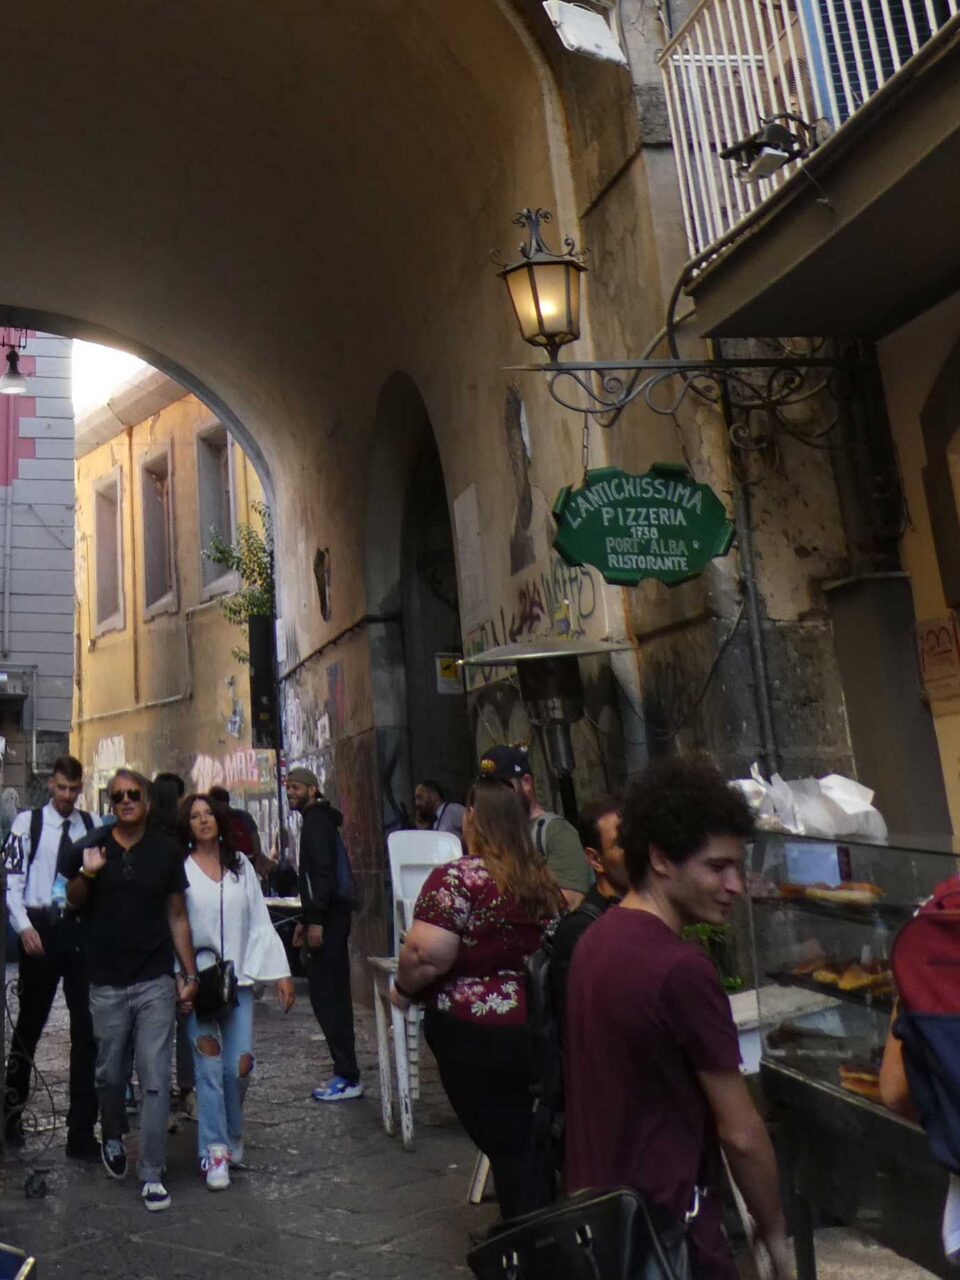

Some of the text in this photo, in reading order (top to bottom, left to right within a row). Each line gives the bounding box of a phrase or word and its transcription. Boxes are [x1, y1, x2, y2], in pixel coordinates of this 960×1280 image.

[565, 477, 702, 529] L'ANTICHISSIMA
[601, 506, 687, 526] PIZZERIA
[630, 526, 658, 539] 1738
[650, 539, 688, 555] ALBA
[608, 554, 688, 570] RISTORANTE
